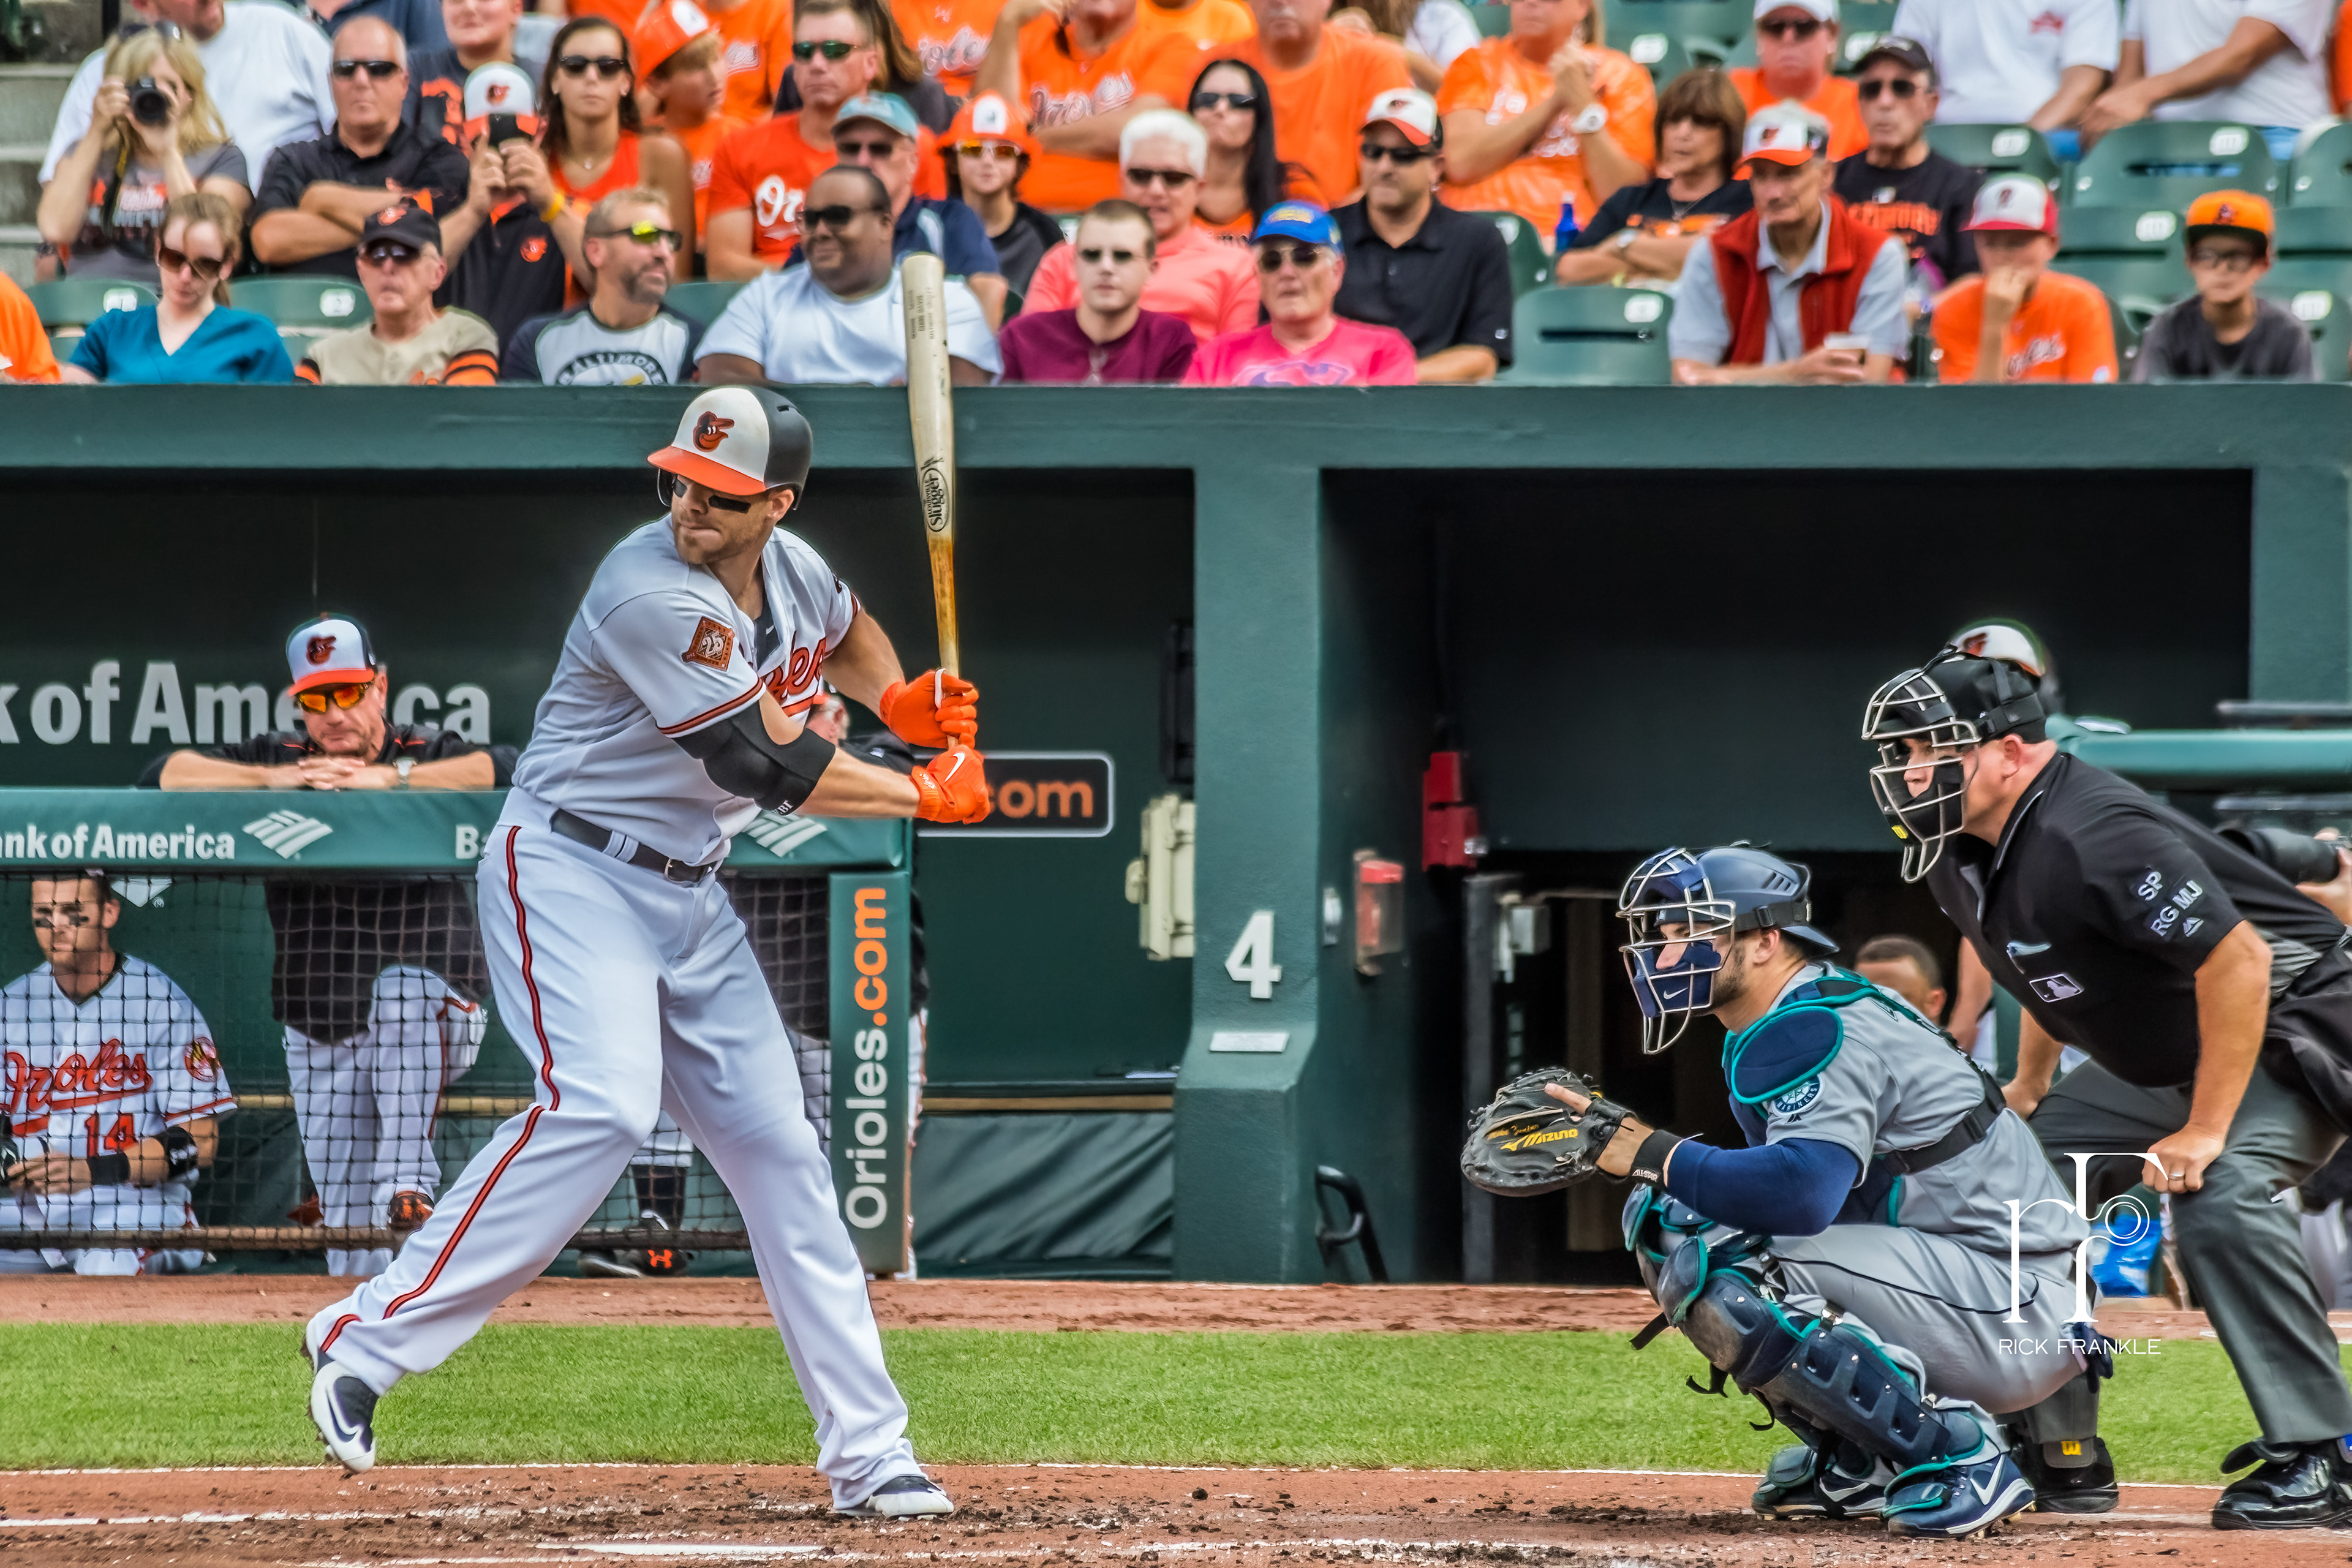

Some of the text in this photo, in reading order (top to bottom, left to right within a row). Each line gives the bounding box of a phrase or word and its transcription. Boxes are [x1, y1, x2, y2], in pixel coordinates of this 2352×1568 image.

[558, 353, 665, 385] BALTIMORE
[929, 474, 945, 526] Slugger
[31, 659, 119, 745] of
[130, 662, 490, 744] Ameca
[0, 823, 235, 859] nk of America
[2138, 871, 2163, 901] SP
[2150, 906, 2179, 937] RG
[1224, 910, 1282, 998] 4
[844, 888, 888, 1229] Orioles.com
[1776, 1088, 1817, 1112] MARINERS
[85, 1113, 140, 1158] 14
